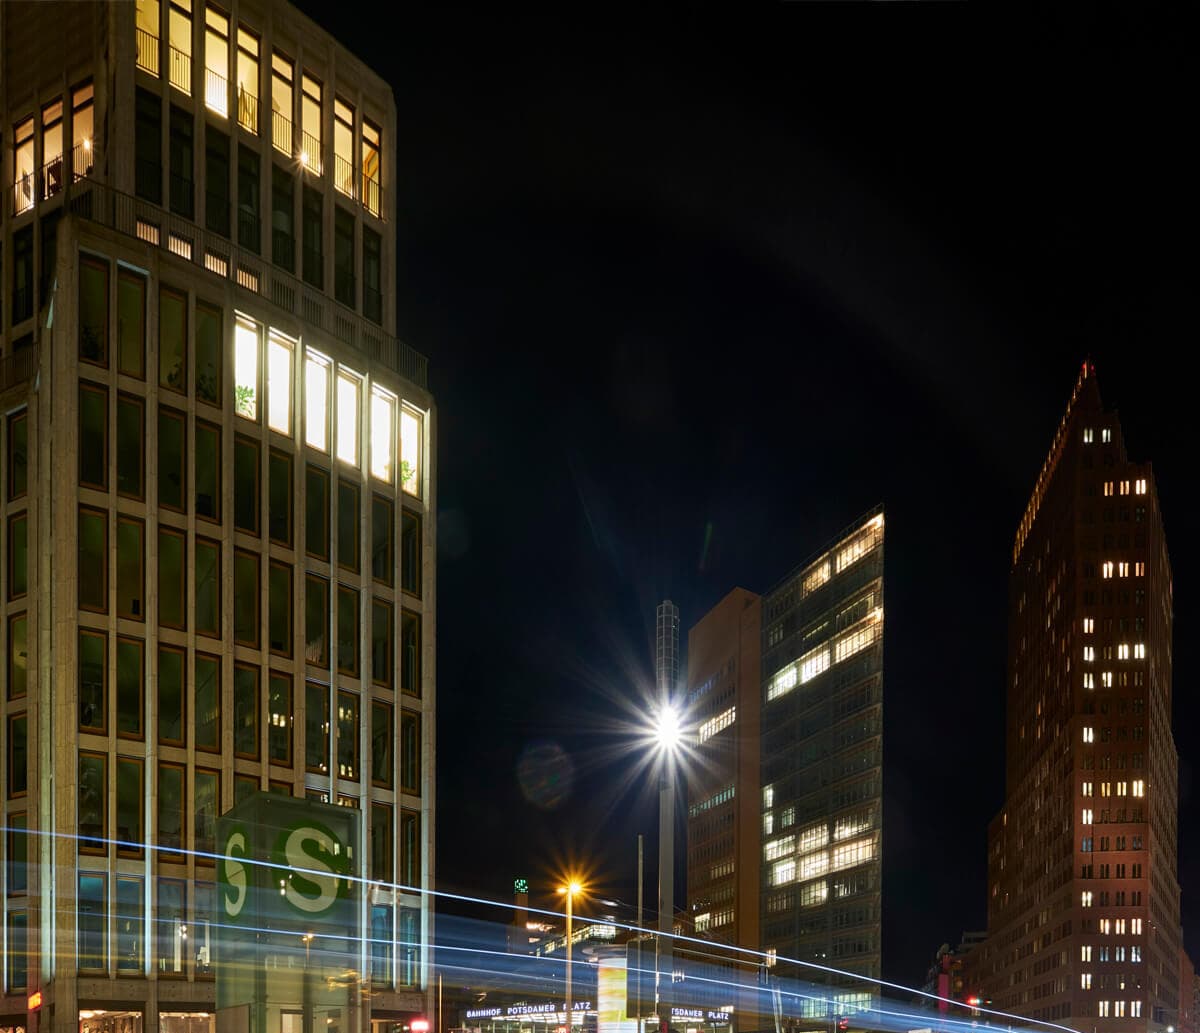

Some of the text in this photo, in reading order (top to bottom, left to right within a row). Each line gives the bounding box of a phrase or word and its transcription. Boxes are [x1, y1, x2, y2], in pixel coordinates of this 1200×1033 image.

[225, 833, 246, 917] S
[286, 827, 338, 912] S
[466, 1002, 591, 1018] BAHNHOF POTSDAMER PATZ
[708, 1011, 729, 1020] PLATZ
